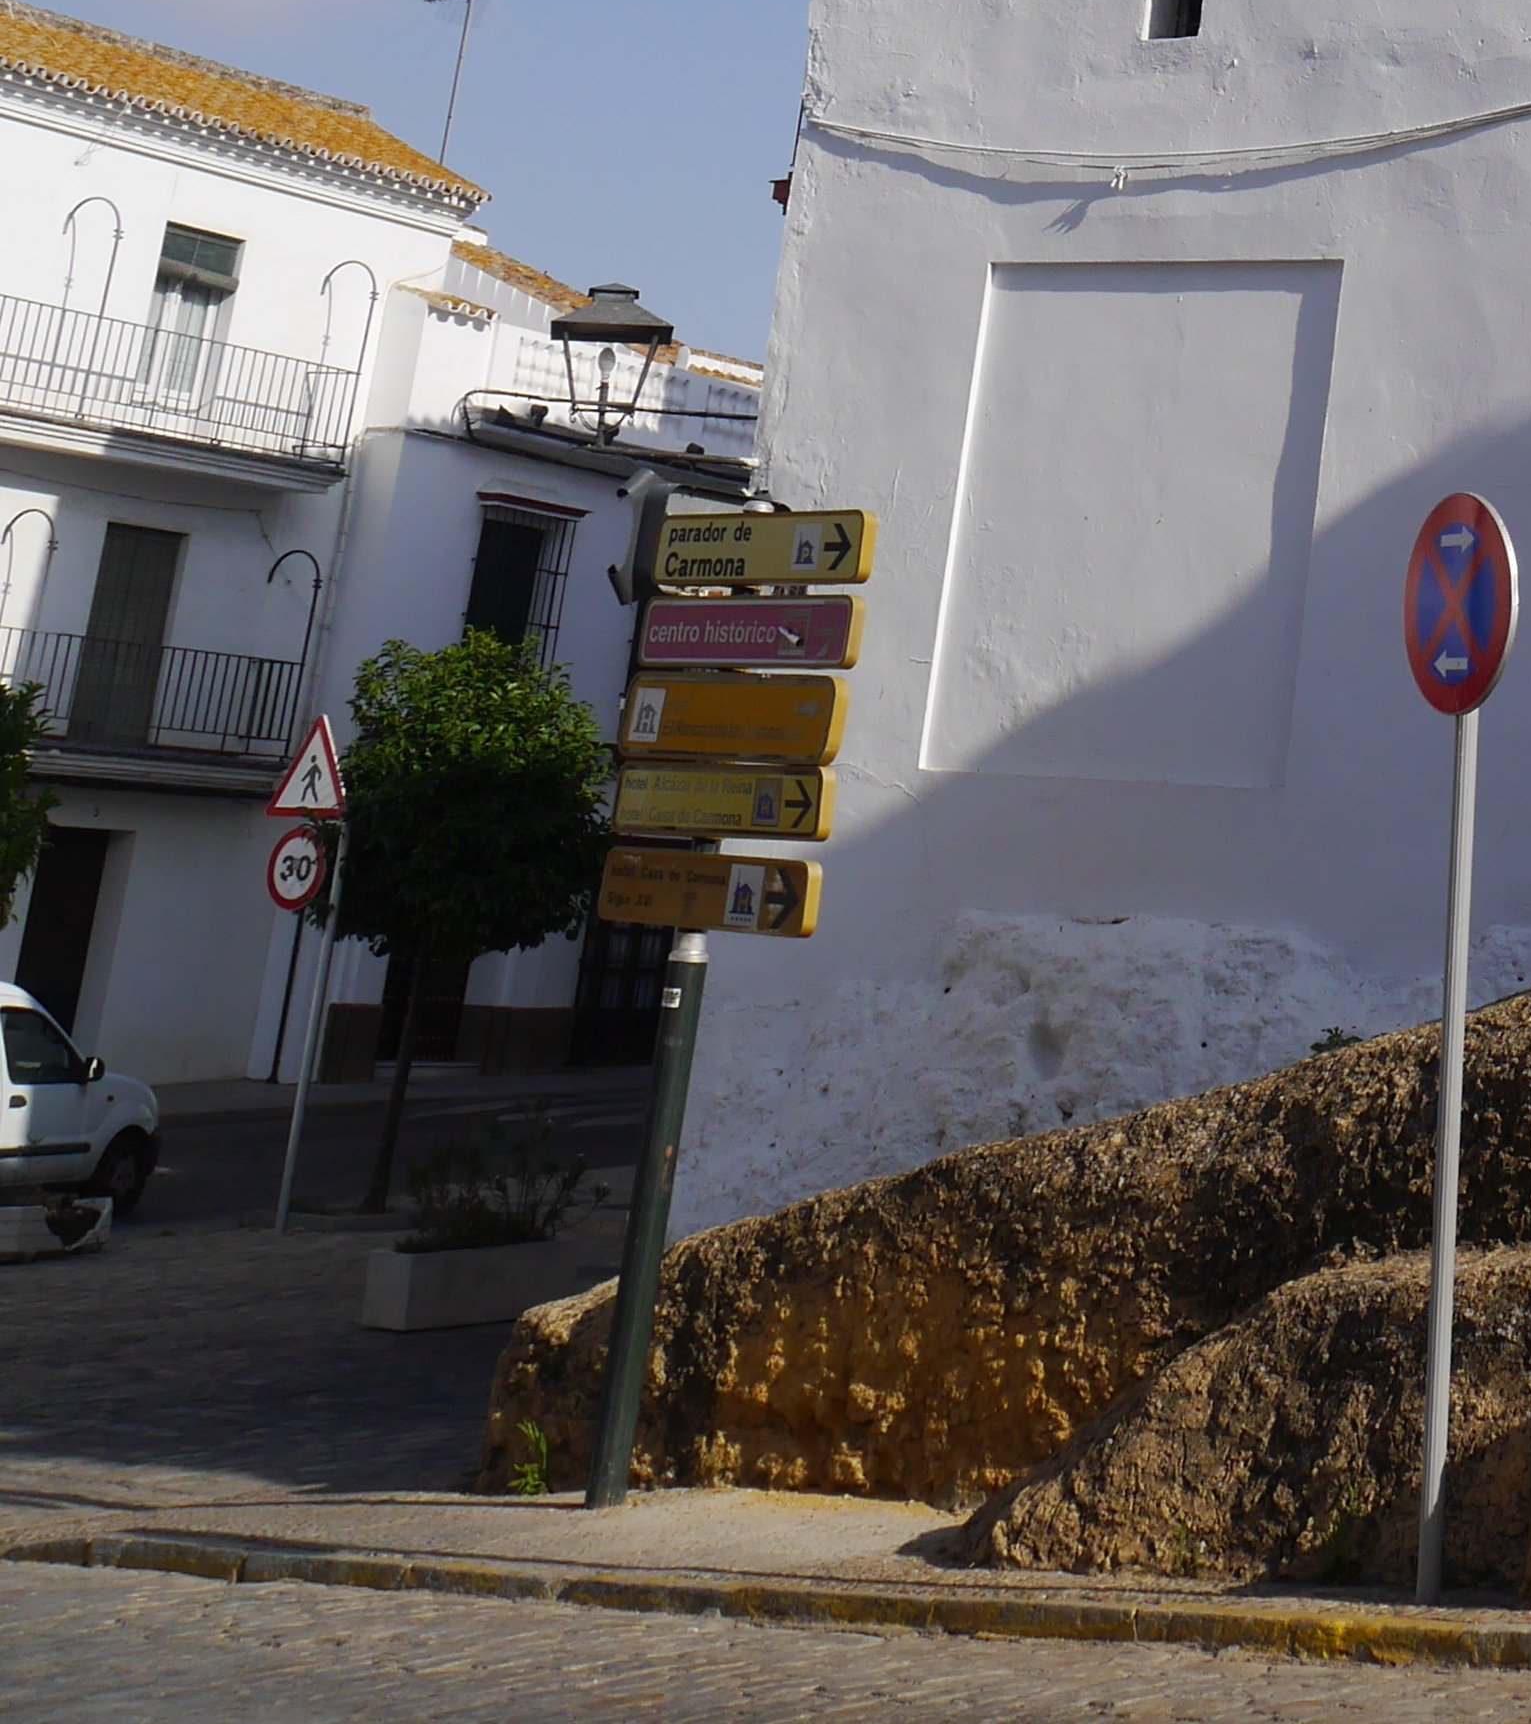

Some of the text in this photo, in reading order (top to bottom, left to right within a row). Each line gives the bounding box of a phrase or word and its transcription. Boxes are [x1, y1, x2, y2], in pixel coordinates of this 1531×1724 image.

[668, 521, 752, 547] parador de
[665, 552, 746, 578] Carmona
[649, 619, 777, 644] centro histórico
[625, 774, 648, 790] hotel
[695, 776, 708, 792] de
[710, 777, 720, 793] la
[722, 778, 753, 795] Reina
[621, 807, 643, 821] hotel
[693, 808, 742, 826] Carmona
[280, 854, 312, 882] 30
